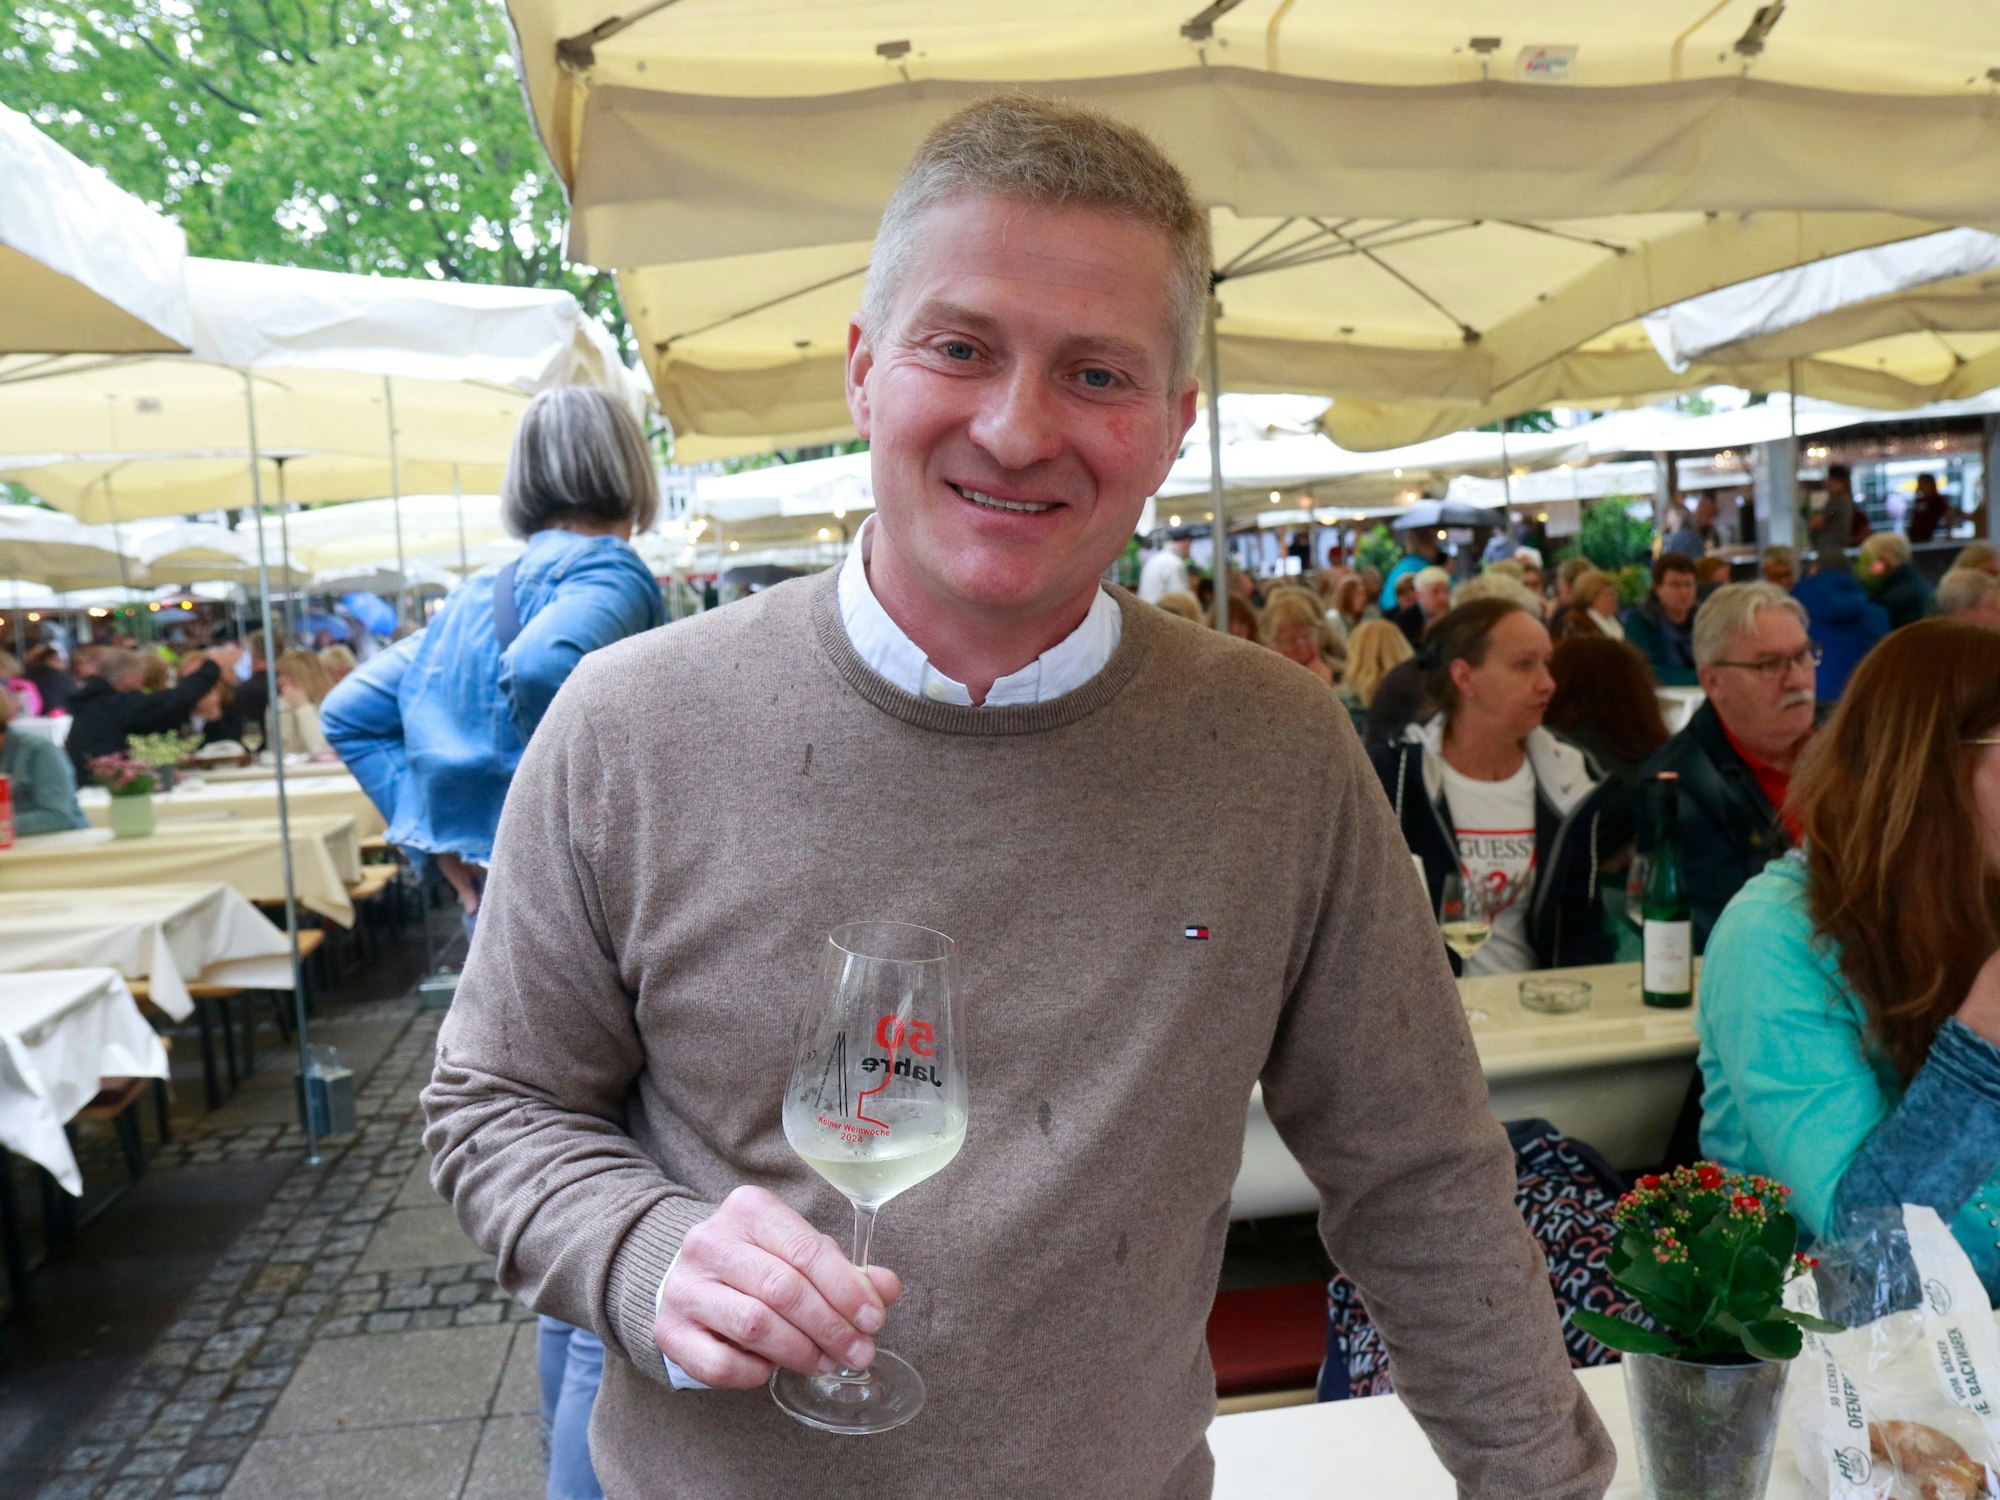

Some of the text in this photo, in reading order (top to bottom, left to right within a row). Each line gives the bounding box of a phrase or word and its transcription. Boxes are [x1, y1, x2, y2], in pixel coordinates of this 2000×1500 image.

[1459, 838, 1530, 859] GUESS
[844, 1123, 890, 1136] Weinwoche
[840, 1133, 864, 1143] 2024
